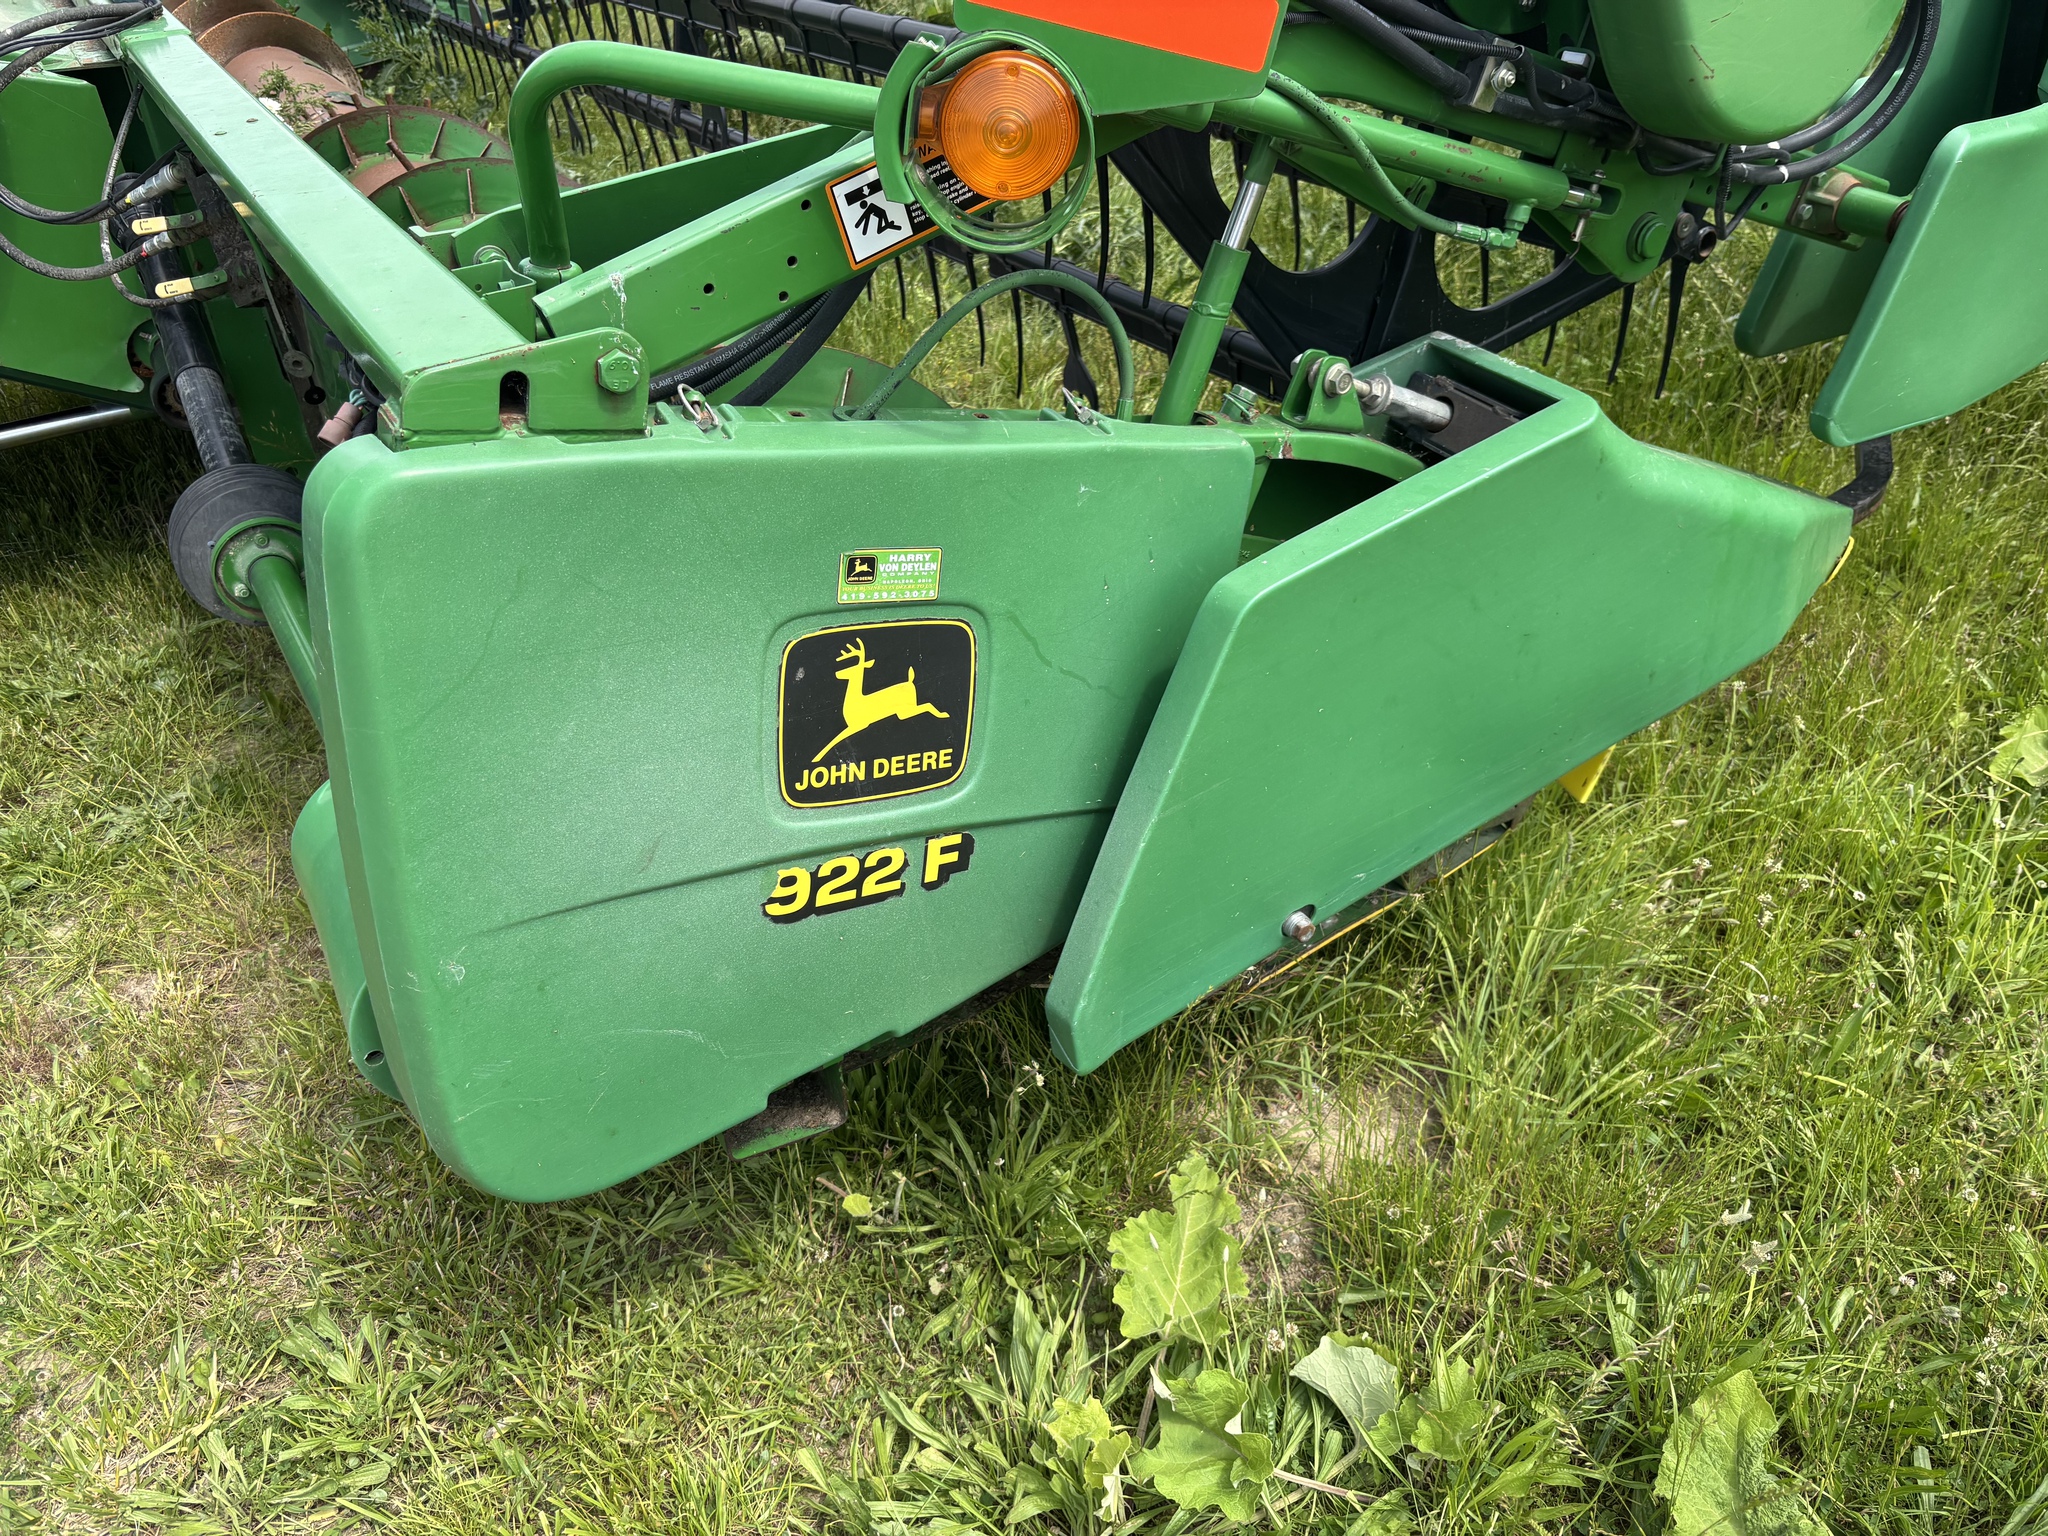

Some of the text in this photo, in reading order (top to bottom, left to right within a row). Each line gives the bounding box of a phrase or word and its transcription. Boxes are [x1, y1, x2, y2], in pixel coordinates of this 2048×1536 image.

[950, 181, 965, 192] engin
[958, 186, 969, 195] and
[913, 191, 974, 223] stop cylinder
[650, 377, 674, 391] FLAME
[674, 362, 711, 382] RESISTANT
[878, 562, 938, 572] VON DEYLEN
[889, 553, 932, 562] HARRY
[795, 748, 953, 791] JOHN DEERE
[763, 833, 966, 919] 922 F
